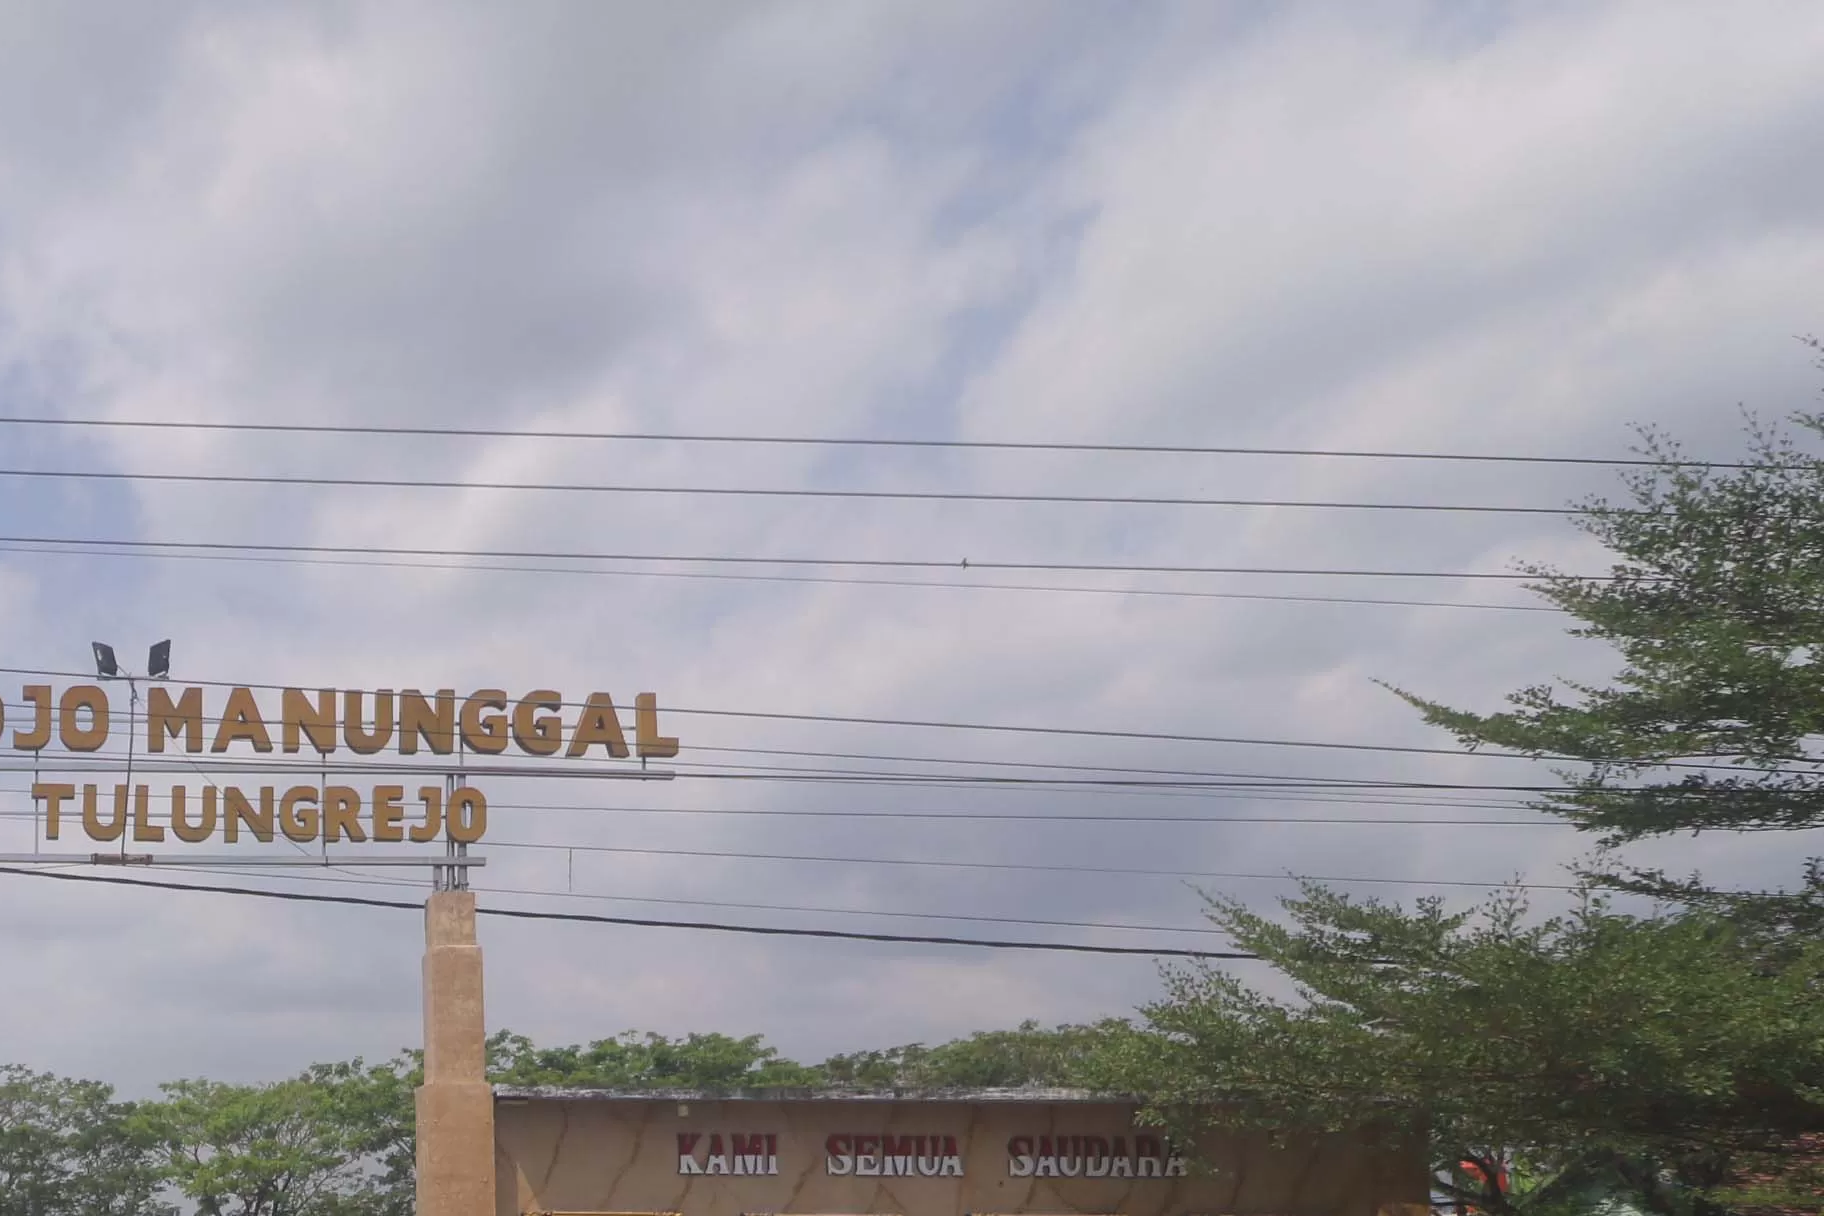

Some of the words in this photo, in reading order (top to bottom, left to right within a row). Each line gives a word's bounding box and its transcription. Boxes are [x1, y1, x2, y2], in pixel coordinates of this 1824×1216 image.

[147, 686, 680, 758] MANUNGGAL
[32, 782, 488, 843] TULUNGREJO
[678, 1132, 779, 1176] KAMI
[825, 1133, 964, 1177] SEMUA
[1007, 1134, 1188, 1178] SAUDARA
